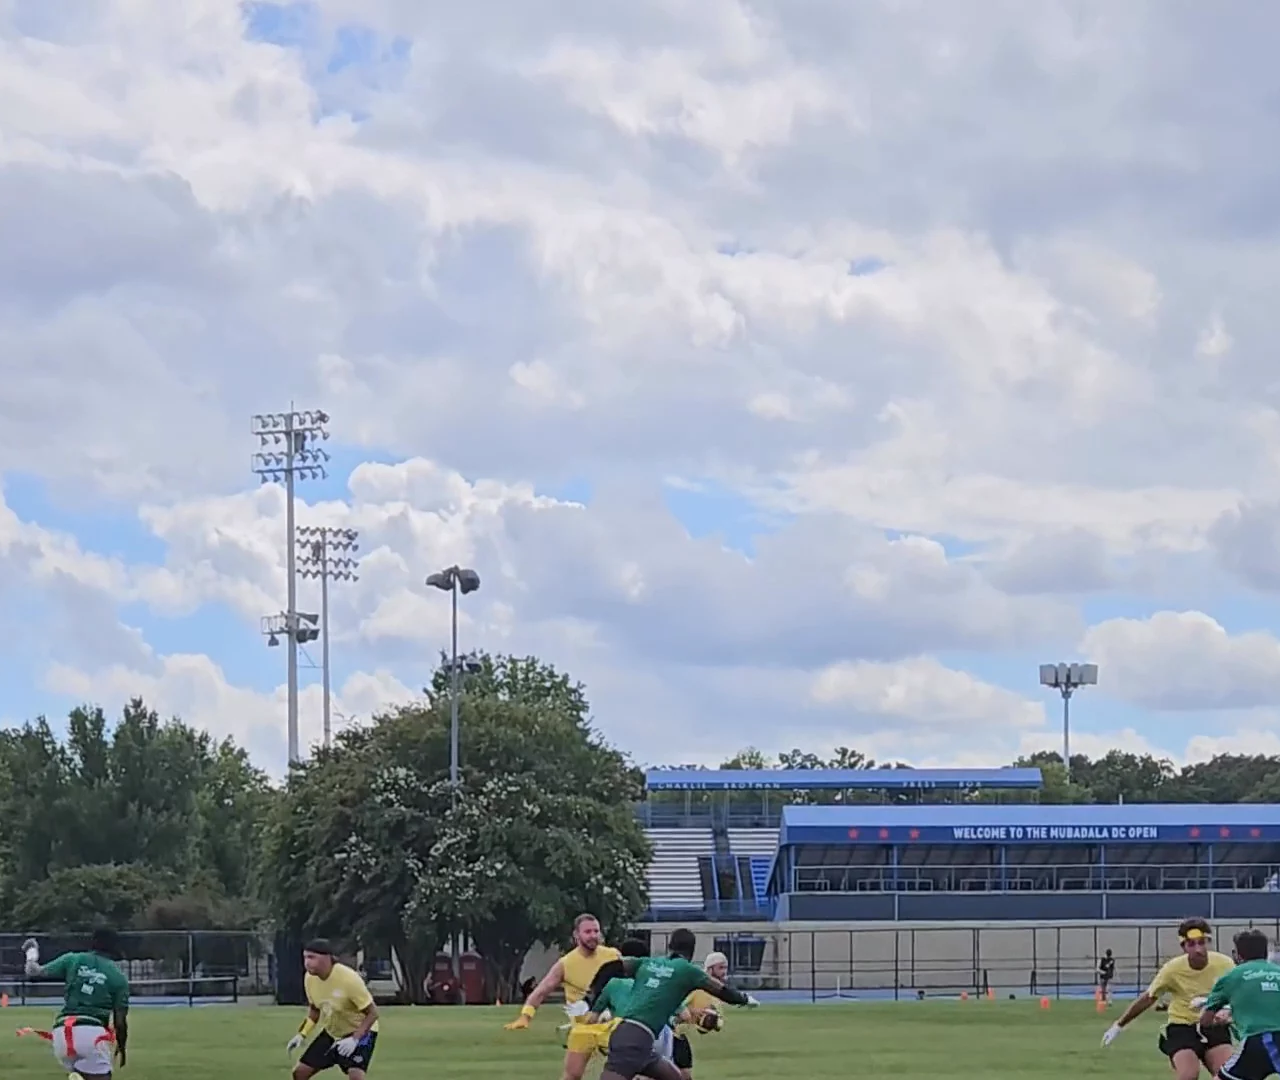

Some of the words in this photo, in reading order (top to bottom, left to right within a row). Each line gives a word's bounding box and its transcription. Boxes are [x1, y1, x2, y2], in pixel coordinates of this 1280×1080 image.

[953, 826, 1006, 839] WELCOME
[1009, 826, 1023, 839] TO
[1026, 826, 1047, 839] THE
[1049, 826, 1109, 839] MUBADALA
[1111, 826, 1126, 839] DC
[1128, 825, 1158, 838] OPEN
